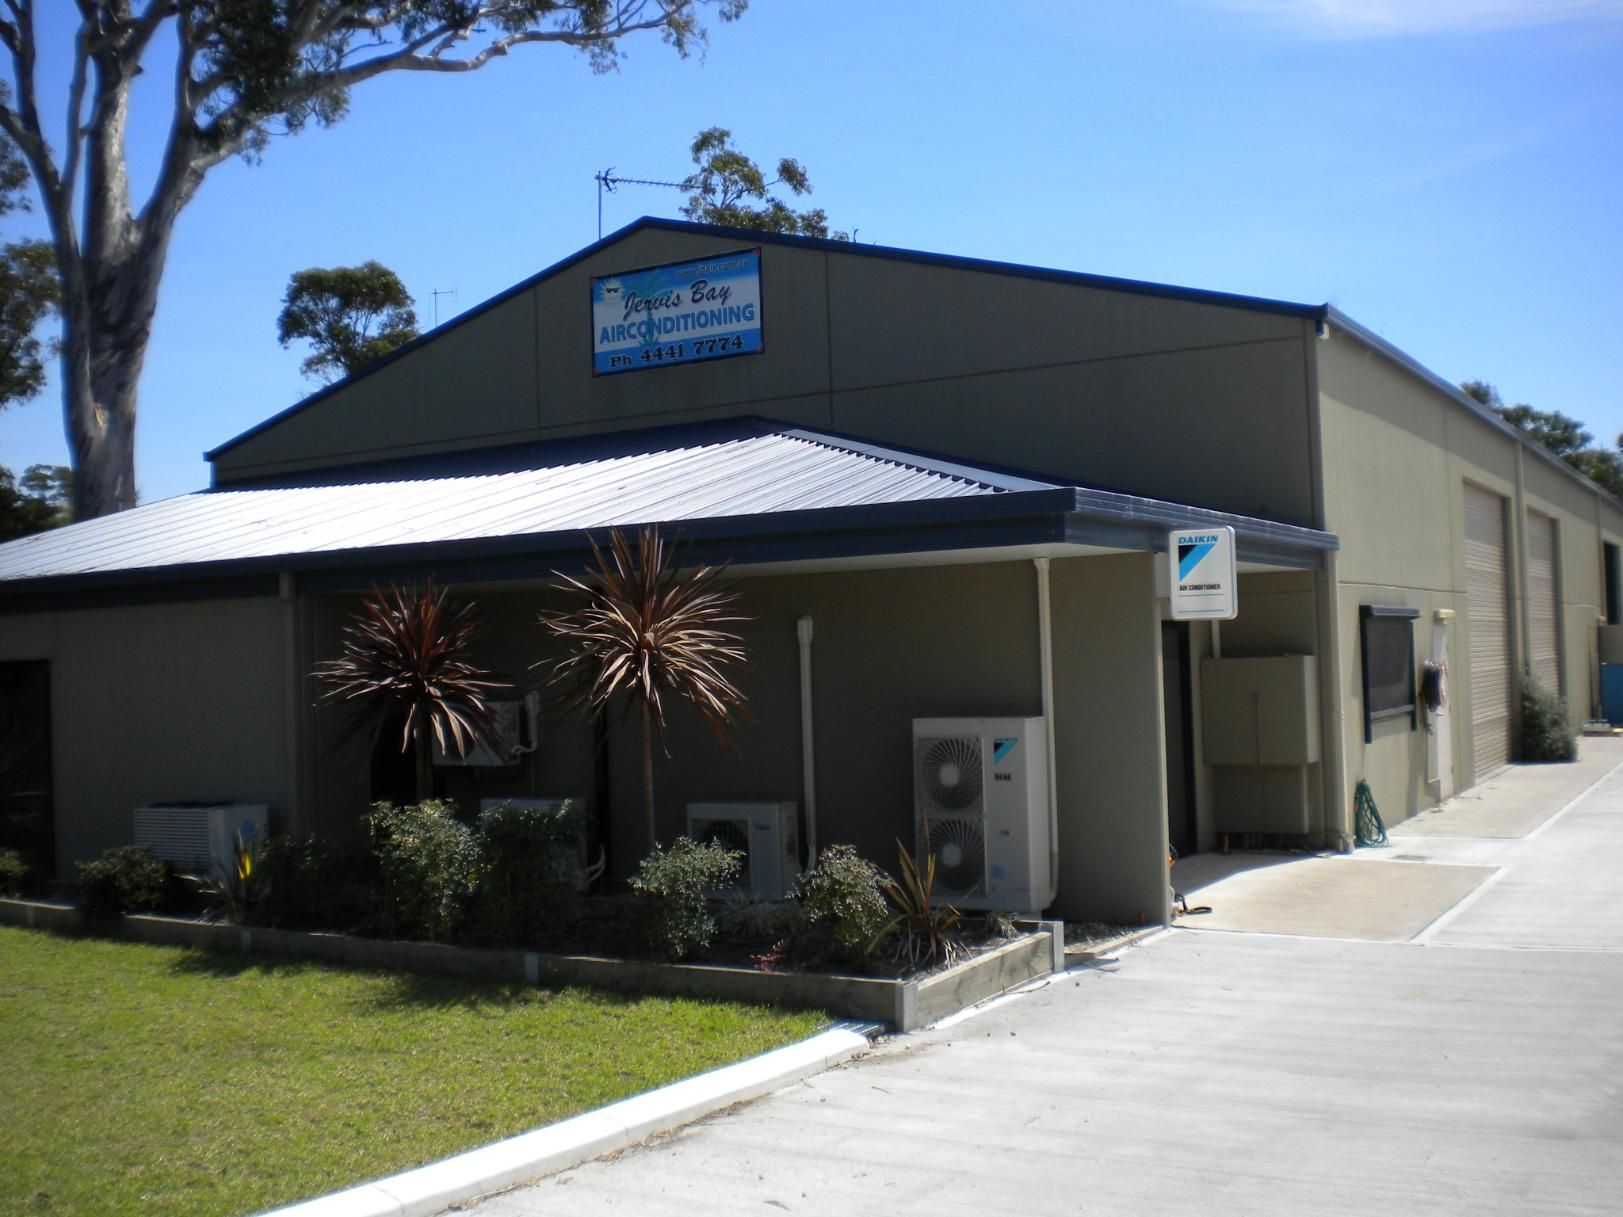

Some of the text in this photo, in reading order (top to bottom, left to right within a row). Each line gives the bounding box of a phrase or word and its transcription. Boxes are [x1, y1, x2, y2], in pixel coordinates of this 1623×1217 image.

[623, 279, 732, 321] Jervis Bay
[600, 302, 755, 344] AIRCONDITIONING
[609, 335, 743, 367] Ph 4441 7774
[1178, 535, 1219, 544] DAIKIN
